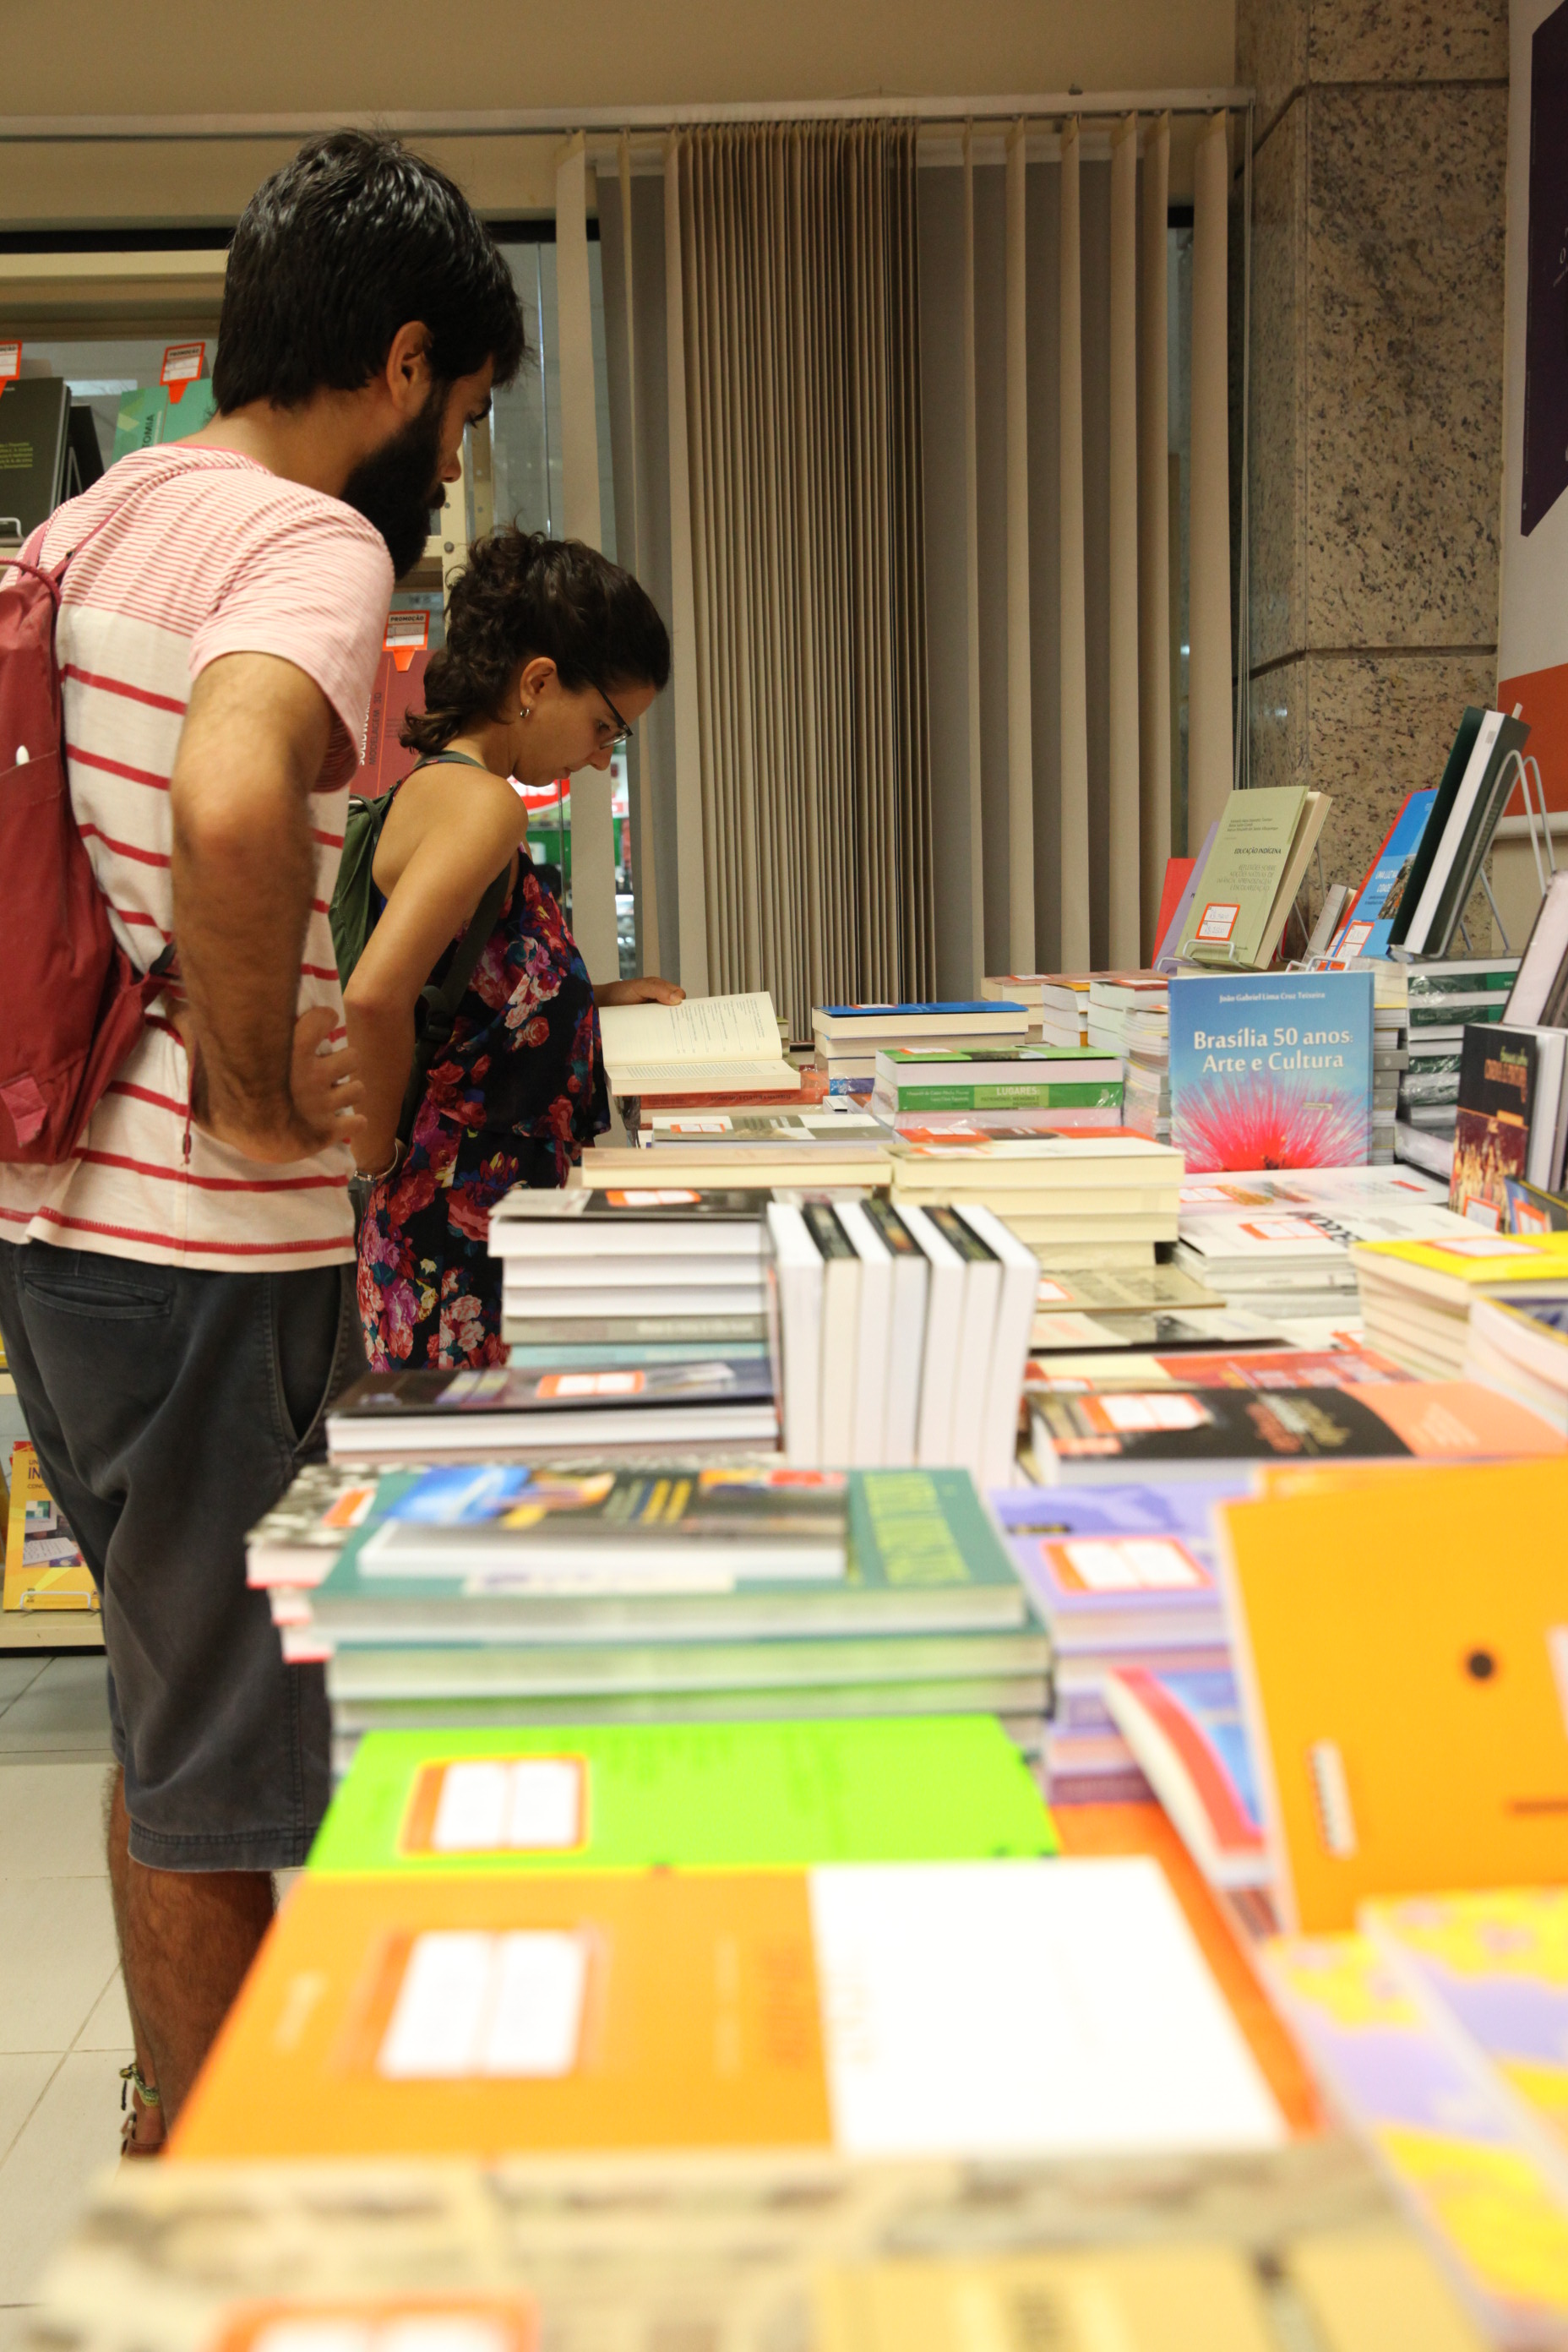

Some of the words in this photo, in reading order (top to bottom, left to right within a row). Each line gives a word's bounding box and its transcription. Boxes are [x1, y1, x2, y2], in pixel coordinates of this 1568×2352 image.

[390, 614, 424, 623] PROMOÇÃO
[373, 692, 382, 705] 3D
[358, 694, 372, 766] SOLIDWO
[369, 710, 379, 765] MODELAGEM
[1234, 847, 1259, 855] EDUCAÇÃO
[1219, 994, 1236, 1003] João
[1236, 993, 1262, 1002] Gabriel
[1298, 991, 1326, 999] Teixeira
[1194, 1027, 1268, 1050] Brasília
[1273, 1027, 1298, 1047] 50
[1303, 1030, 1353, 1046] anos:
[1202, 1054, 1246, 1073] Arte
[1251, 1057, 1262, 1071] e
[1268, 1049, 1343, 1071] Cultura
[996, 1086, 1041, 1096] LUGARES:
